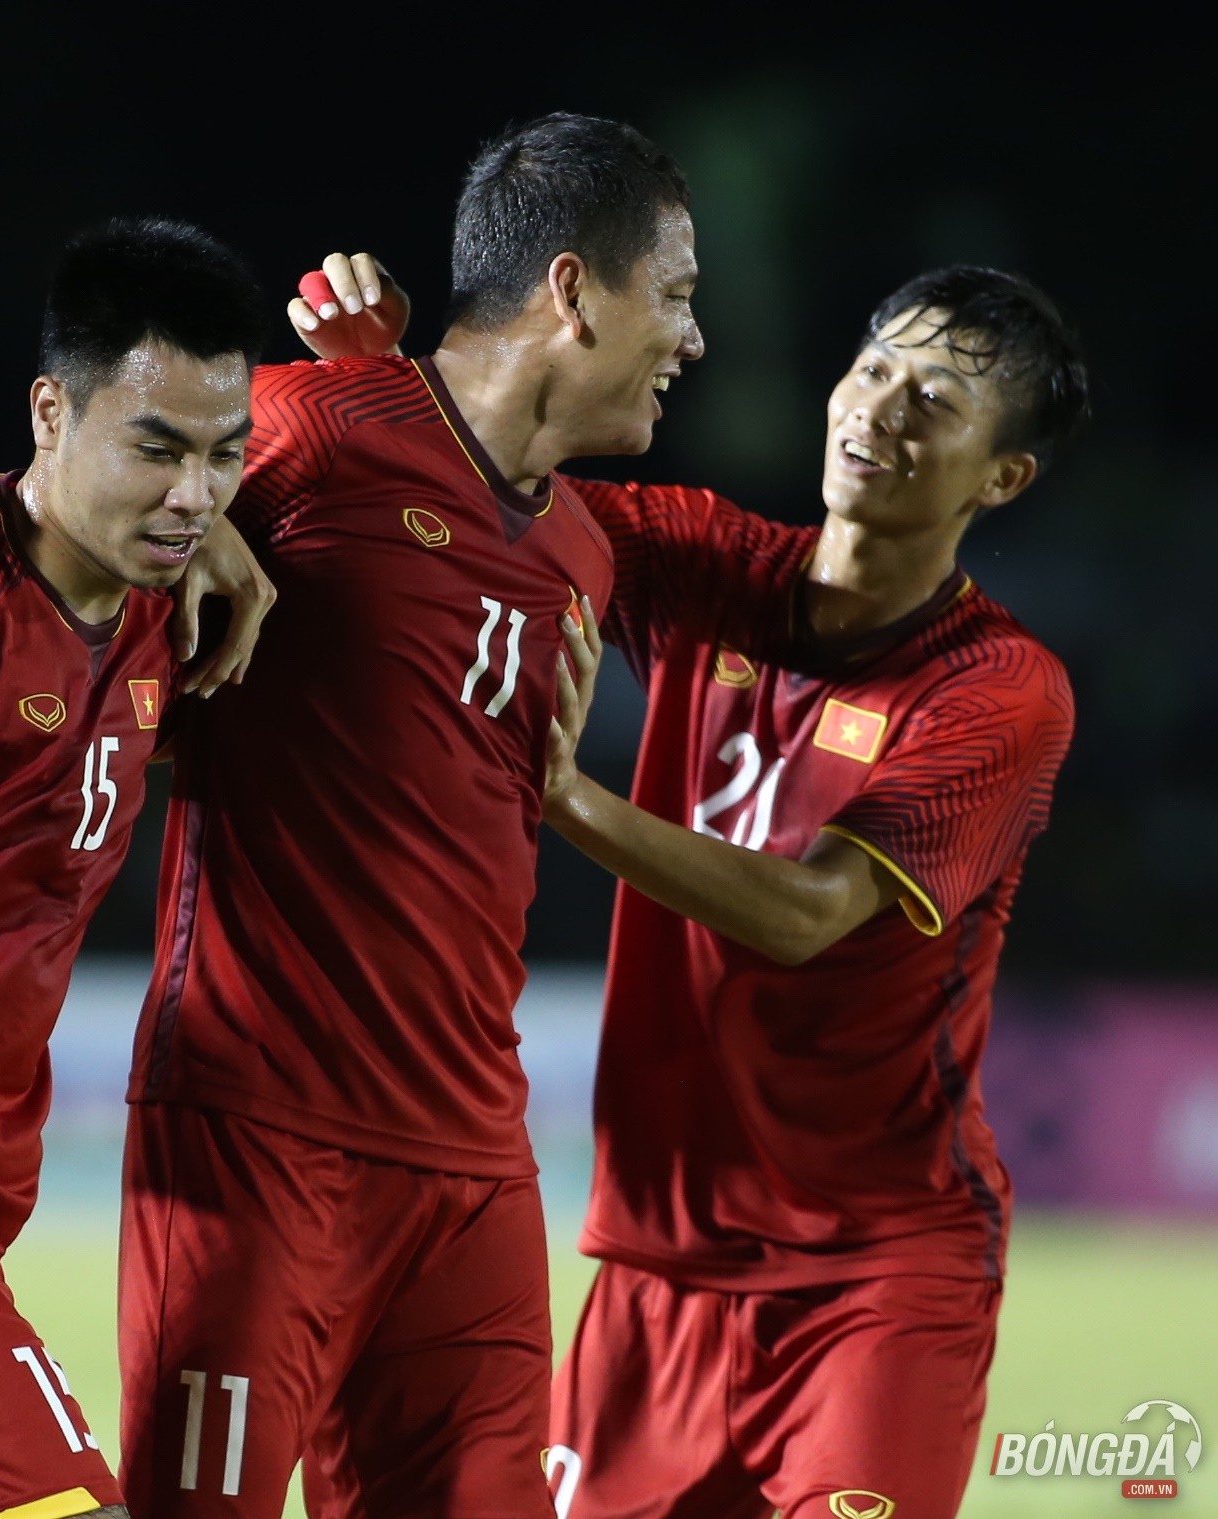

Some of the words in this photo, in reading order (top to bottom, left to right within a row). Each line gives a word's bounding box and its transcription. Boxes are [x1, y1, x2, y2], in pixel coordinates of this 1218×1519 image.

[460, 596, 528, 718] 11
[70, 736, 120, 851] 15
[692, 732, 786, 852] 21
[180, 1369, 250, 1496] 11
